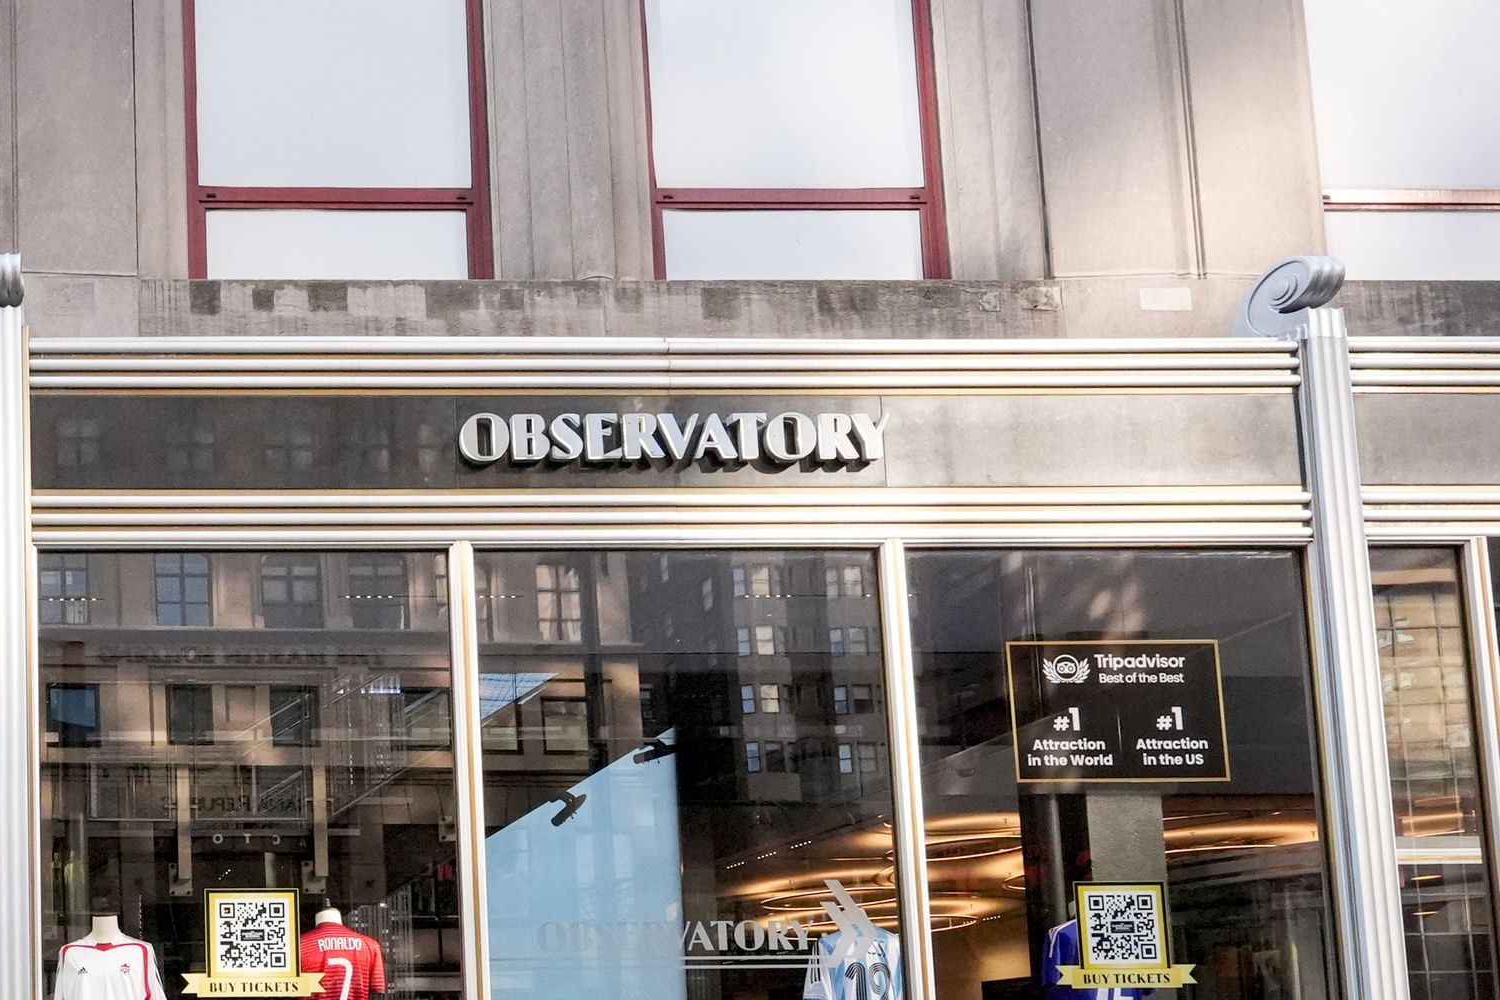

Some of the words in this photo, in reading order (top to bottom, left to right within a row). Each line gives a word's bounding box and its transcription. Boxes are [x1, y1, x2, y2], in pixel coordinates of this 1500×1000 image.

[459, 412, 889, 462] OBSERVATORY
[1094, 654, 1186, 671] Tripadvisor
[1098, 673, 1124, 684] Best
[1125, 673, 1138, 684] of
[1138, 673, 1157, 684] the
[1159, 672, 1185, 683] Best
[1053, 707, 1081, 731] #1
[1156, 706, 1184, 730] #1
[1033, 738, 1106, 750] Attraction
[1136, 737, 1209, 750] Attraction
[1027, 754, 1041, 766] in
[1043, 754, 1067, 766] the
[1069, 754, 1113, 766] World
[1143, 754, 1156, 765] in
[1159, 754, 1182, 765] the
[1185, 753, 1204, 765] US
[318, 937, 362, 951] RONALDO
[1083, 973, 1110, 984] BUY
[1114, 973, 1171, 984] TICKETS
[209, 981, 239, 993] BUY
[242, 981, 299, 993] TICKETS
